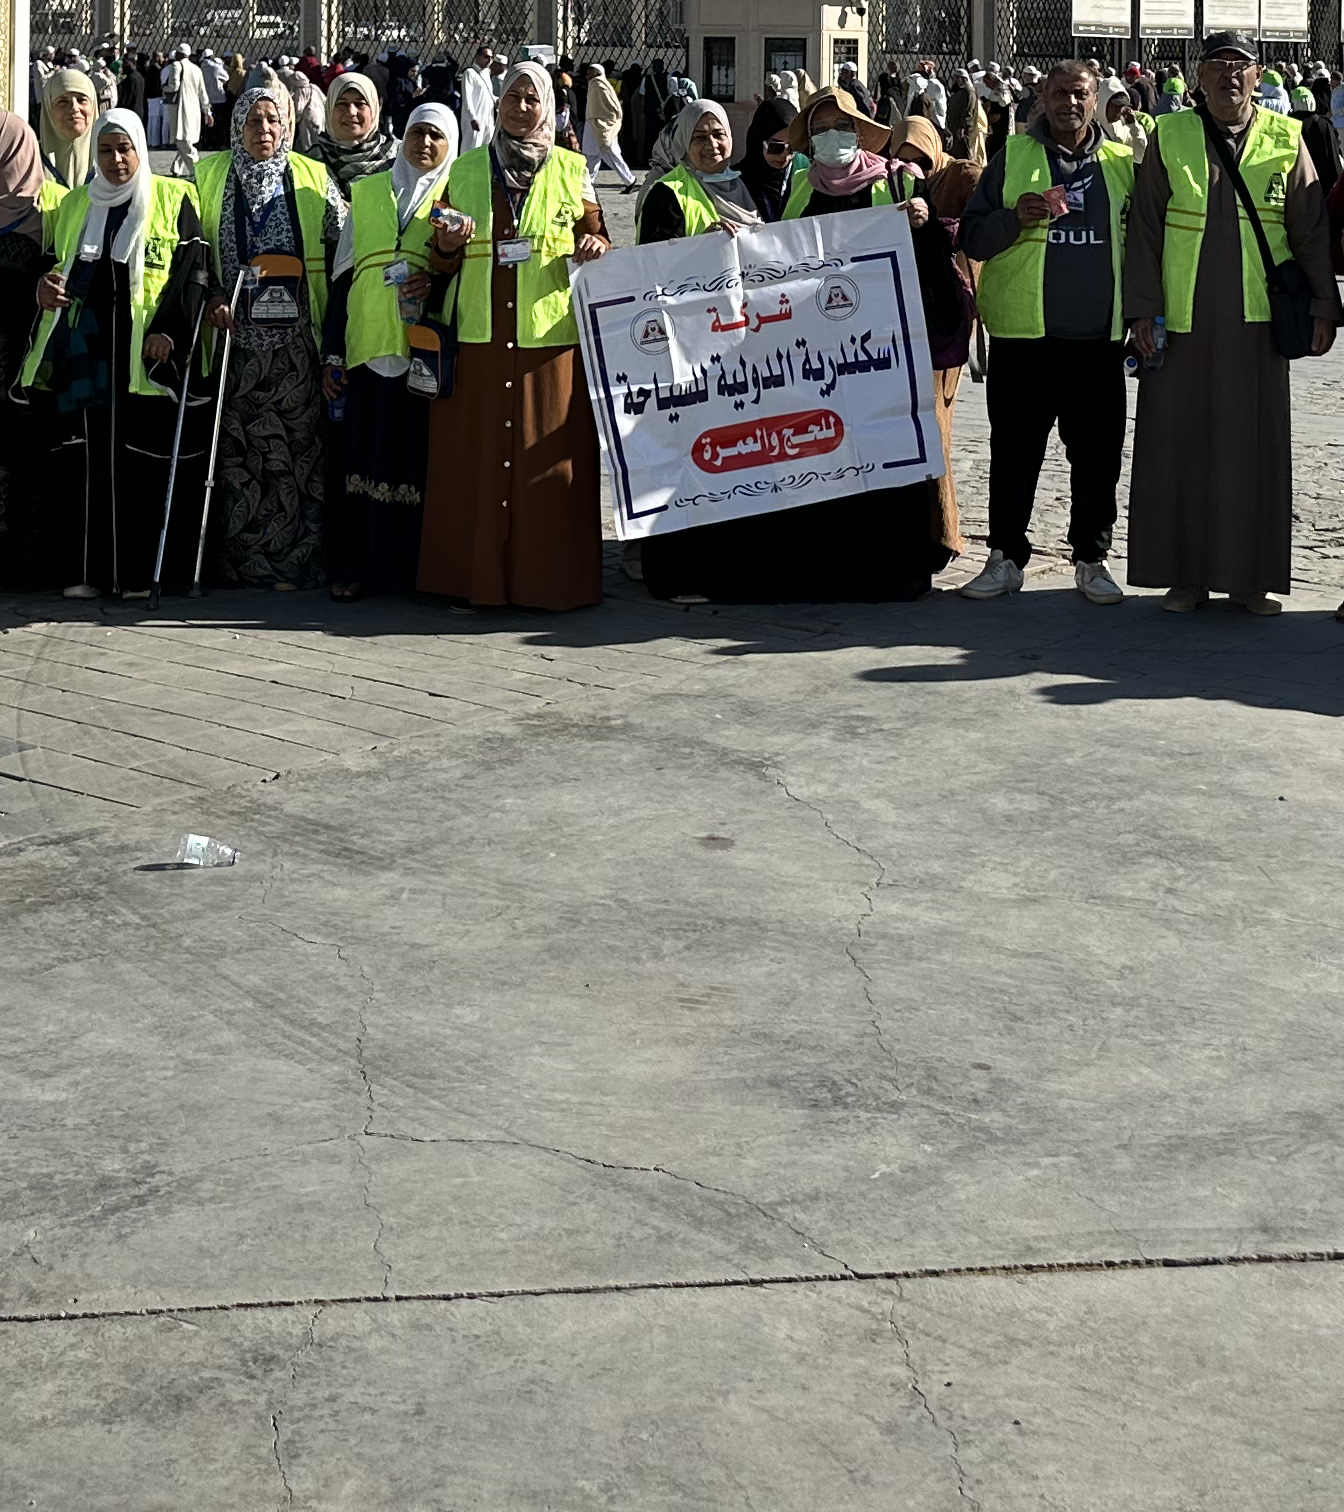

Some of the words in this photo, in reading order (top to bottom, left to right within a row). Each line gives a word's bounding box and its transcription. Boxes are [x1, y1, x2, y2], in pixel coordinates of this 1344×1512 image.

[706, 292, 793, 334] شركة
[710, 345, 795, 411] الدولية
[795, 329, 900, 399] اسكندرية
[616, 362, 709, 424] للسياحة
[702, 426, 780, 467] والعمرة
[782, 415, 836, 456] للحج
